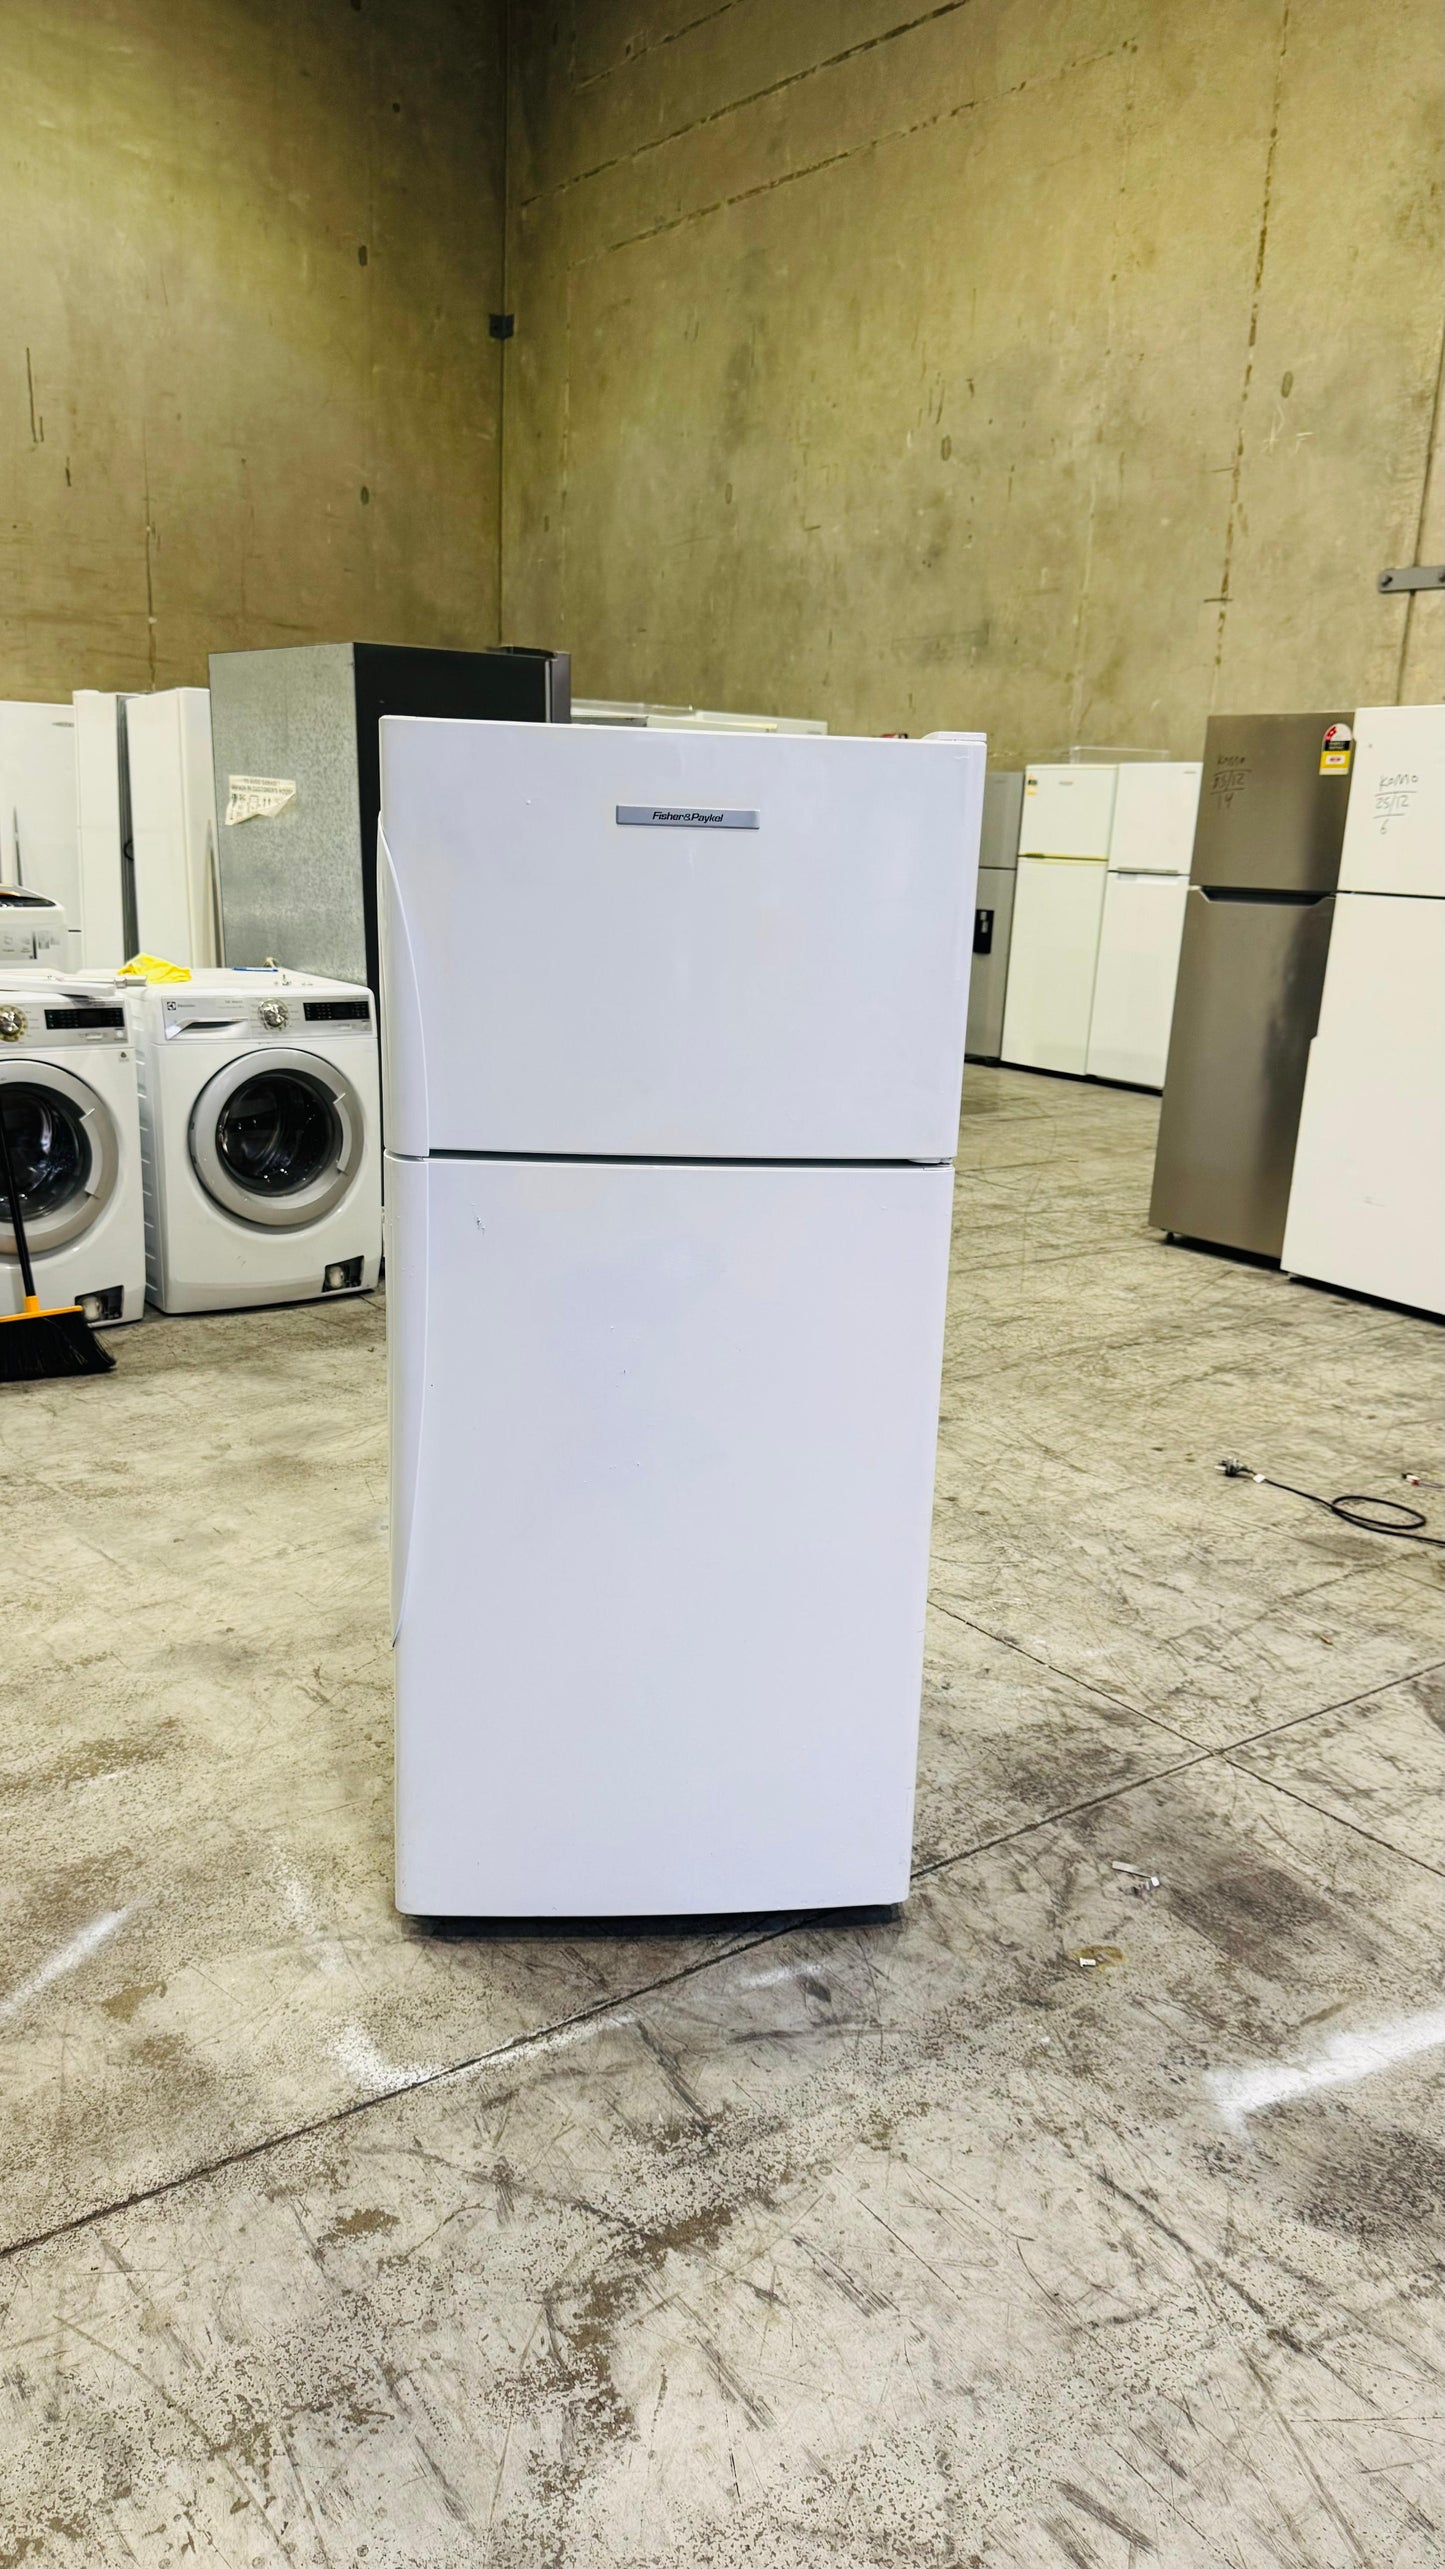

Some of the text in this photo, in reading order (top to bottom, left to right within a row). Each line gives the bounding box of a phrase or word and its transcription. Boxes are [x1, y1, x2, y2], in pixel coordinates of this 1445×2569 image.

[1375, 795, 1409, 813] 25/12
[652, 811, 723, 824] Fisher&Paykel
[1380, 818, 1390, 835] 6
